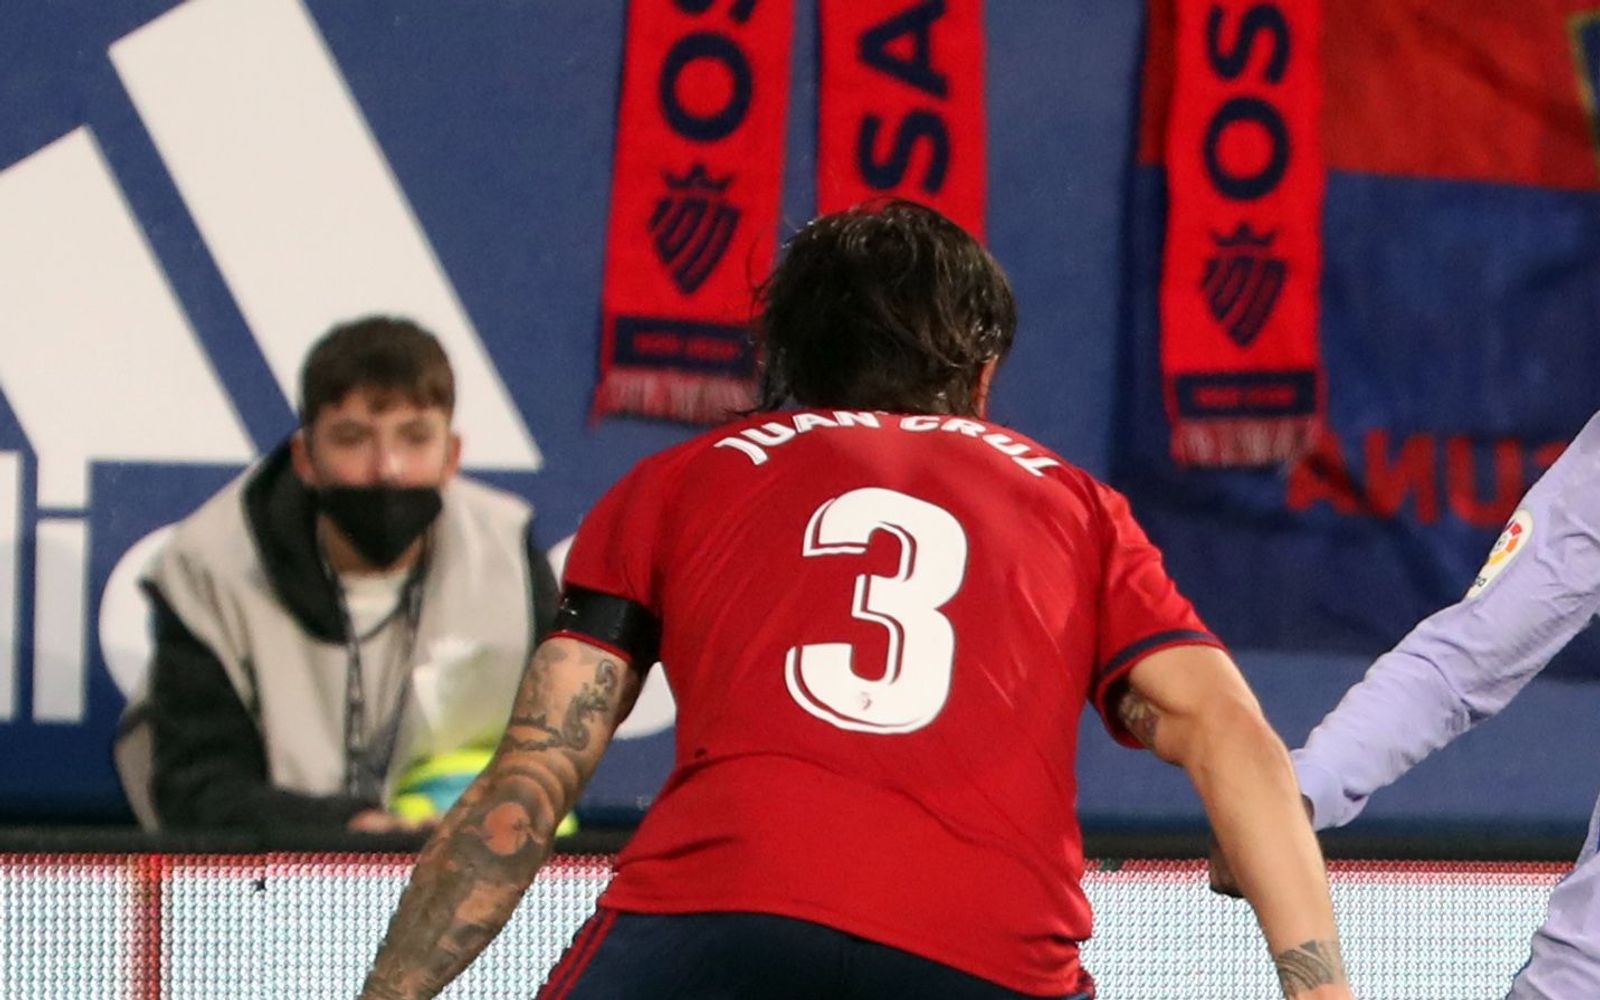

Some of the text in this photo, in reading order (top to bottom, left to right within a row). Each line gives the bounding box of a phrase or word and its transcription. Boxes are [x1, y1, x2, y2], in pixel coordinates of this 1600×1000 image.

[1203, 4, 1292, 200] OS
[714, 410, 880, 466] JUAN
[784, 486, 968, 735] 3
